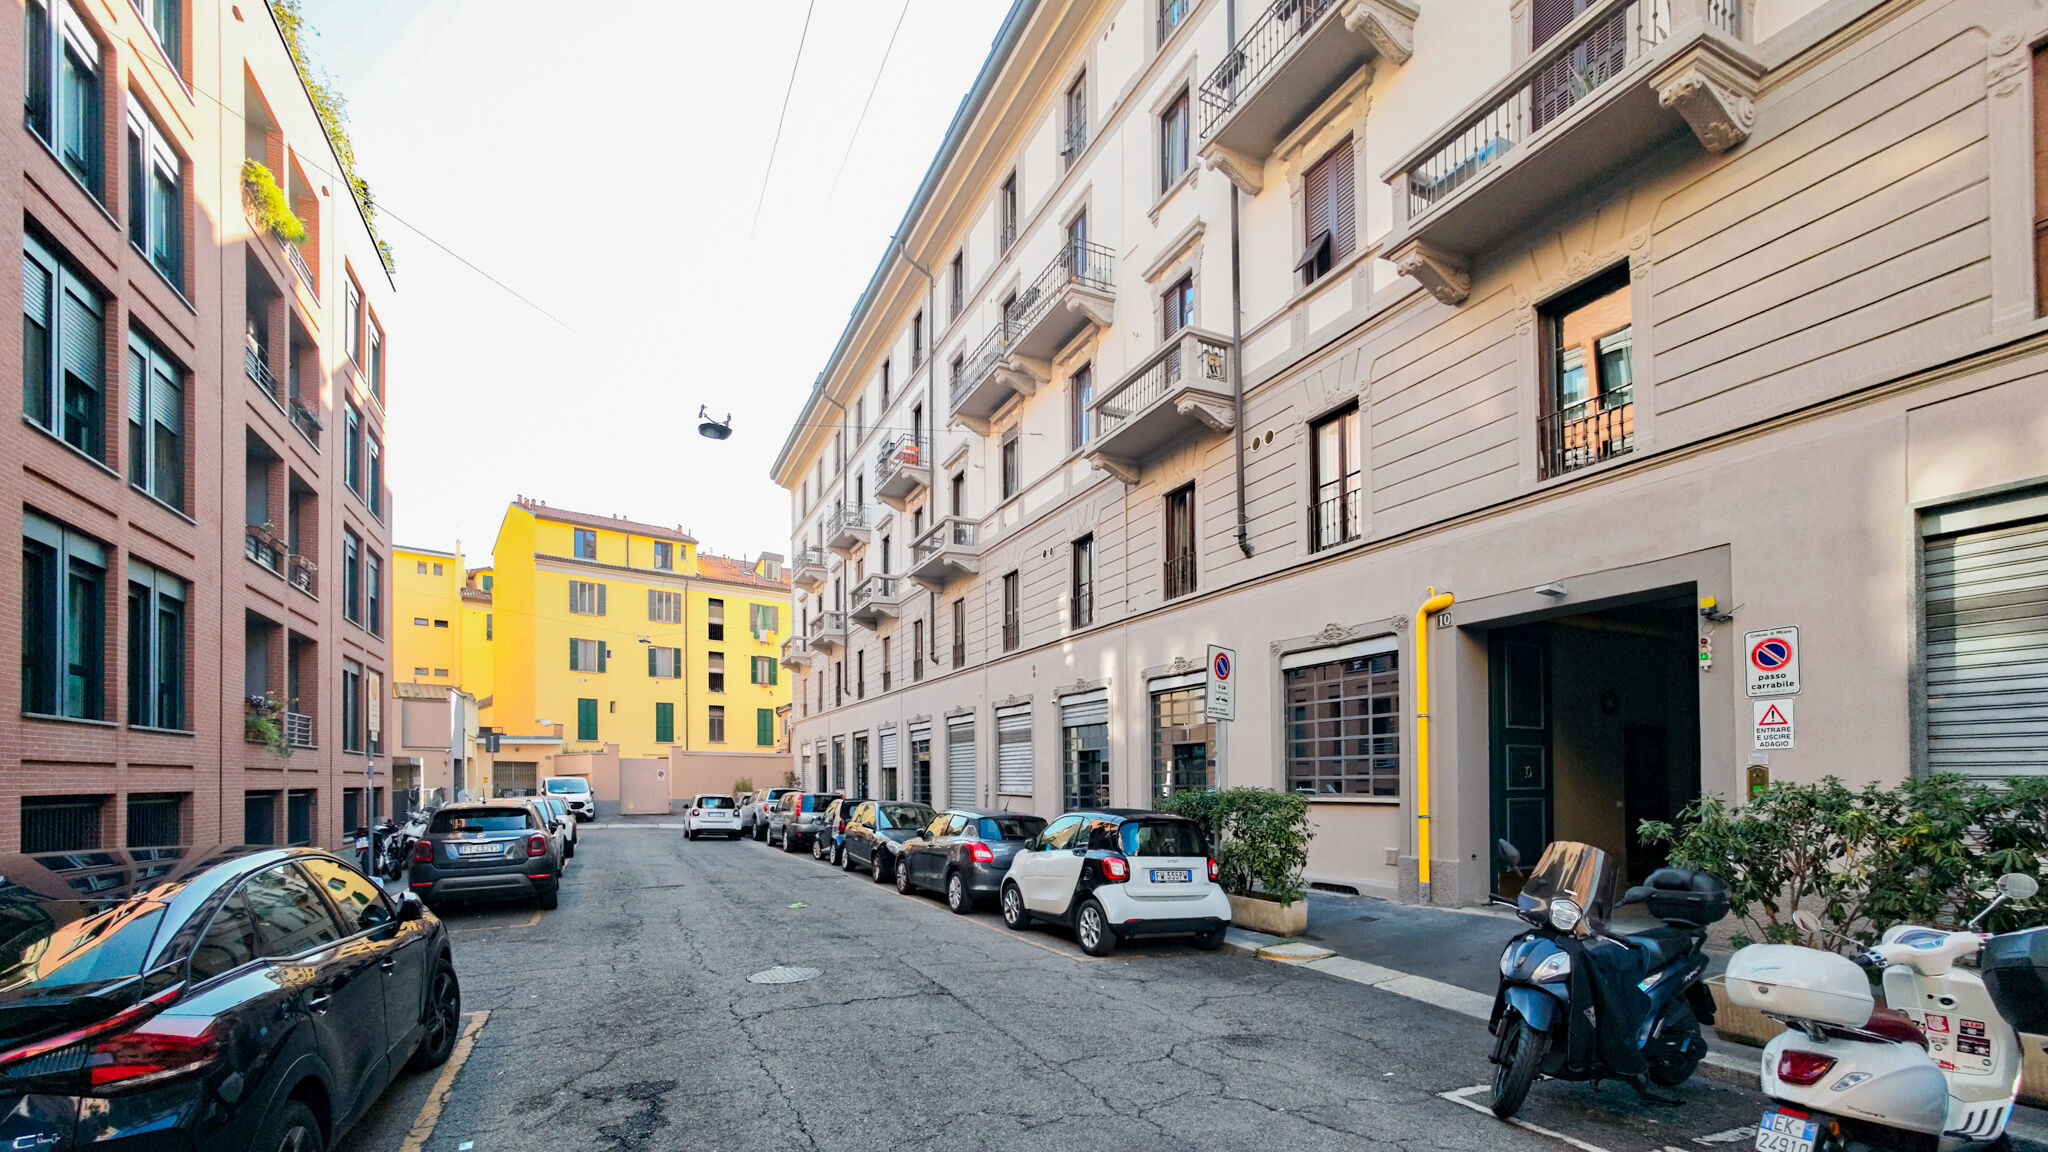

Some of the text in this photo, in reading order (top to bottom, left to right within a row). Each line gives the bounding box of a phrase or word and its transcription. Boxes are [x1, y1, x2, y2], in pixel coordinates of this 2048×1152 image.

[1439, 614, 1451, 626] 10
[1758, 673, 1787, 682] passo
[1751, 680, 1795, 690] carrabile
[1763, 733, 1792, 741] USCIRE
[1774, 1115, 1796, 1134] EK
[13, 1133, 61, 1149] C4
